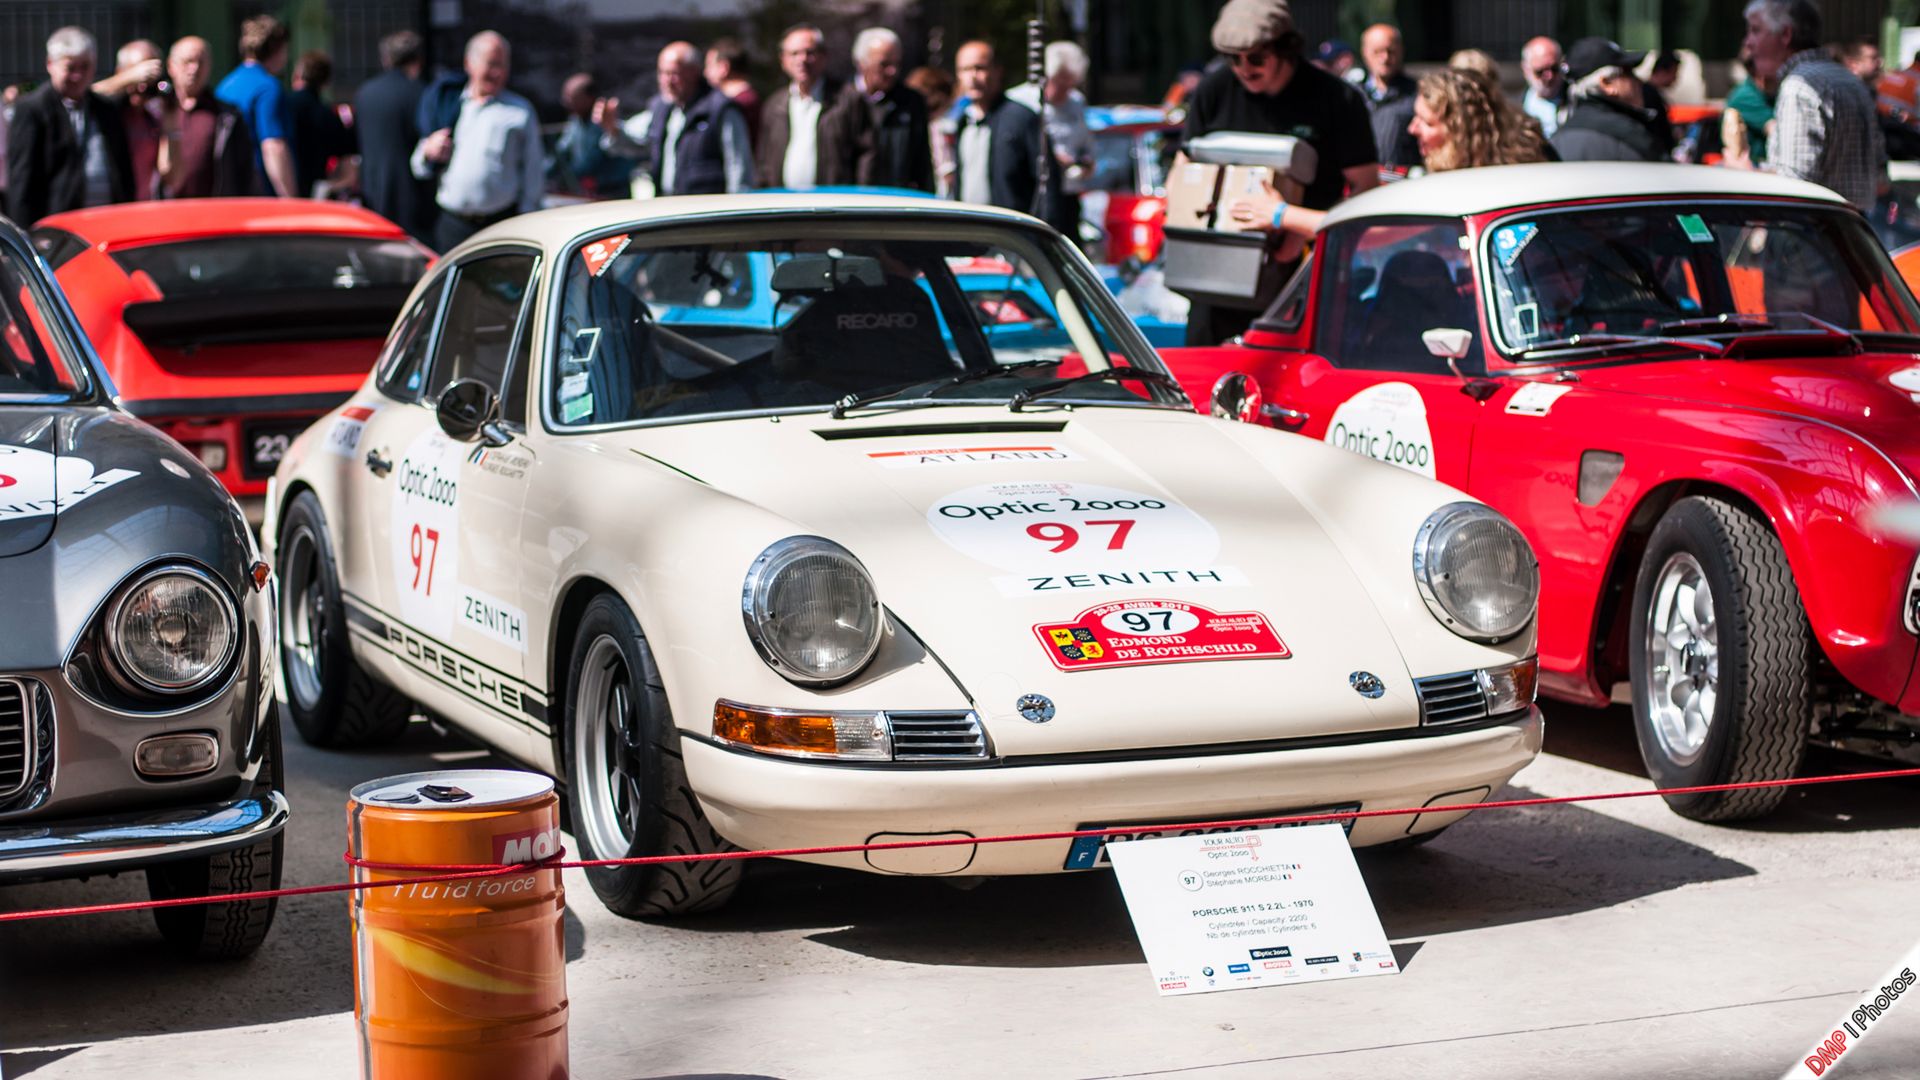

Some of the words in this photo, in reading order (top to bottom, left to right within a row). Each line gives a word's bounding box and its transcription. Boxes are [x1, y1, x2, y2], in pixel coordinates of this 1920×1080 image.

[587, 243, 608, 263] 2
[837, 312, 917, 329] RECARO
[919, 451, 1069, 464] ATLAND
[1384, 430, 1429, 467] 2000
[399, 458, 428, 504] Optic
[428, 467, 457, 506] 2000
[0, 480, 108, 516] NITH
[939, 500, 1057, 521] Optic
[1059, 498, 1166, 512] 2000
[1025, 519, 1136, 553] 97
[410, 523, 439, 596] 97
[1027, 569, 1223, 591] ZENITH
[1123, 601, 1159, 610] AVRIL
[465, 595, 521, 642] ZENITH
[1121, 611, 1173, 632] 97
[1106, 635, 1187, 648] EDMOND
[1115, 649, 1137, 660] DE
[1137, 642, 1258, 658] ROTHSCHILD
[390, 627, 520, 710] PORSCHE
[1077, 852, 1089, 862] F
[1207, 850, 1229, 860] Optic
[1231, 849, 1250, 858] 2000
[1184, 876, 1196, 885] 97
[1203, 868, 1237, 879] Georges
[1237, 863, 1292, 875] ROCCHIETTA
[1244, 873, 1283, 884] MOREAU
[393, 879, 471, 900] fluid
[475, 875, 537, 897] force
[1192, 905, 1239, 918] PORSCHE
[1240, 904, 1256, 913] 911
[1258, 903, 1265, 912] S
[1266, 901, 1286, 911] 2.2L
[1293, 899, 1314, 908] 1970
[1288, 913, 1308, 923] 2200
[1206, 931, 1219, 940] Nb
[1220, 930, 1231, 939] de
[1231, 925, 1266, 938] cylindres
[1310, 922, 1318, 930] 6
